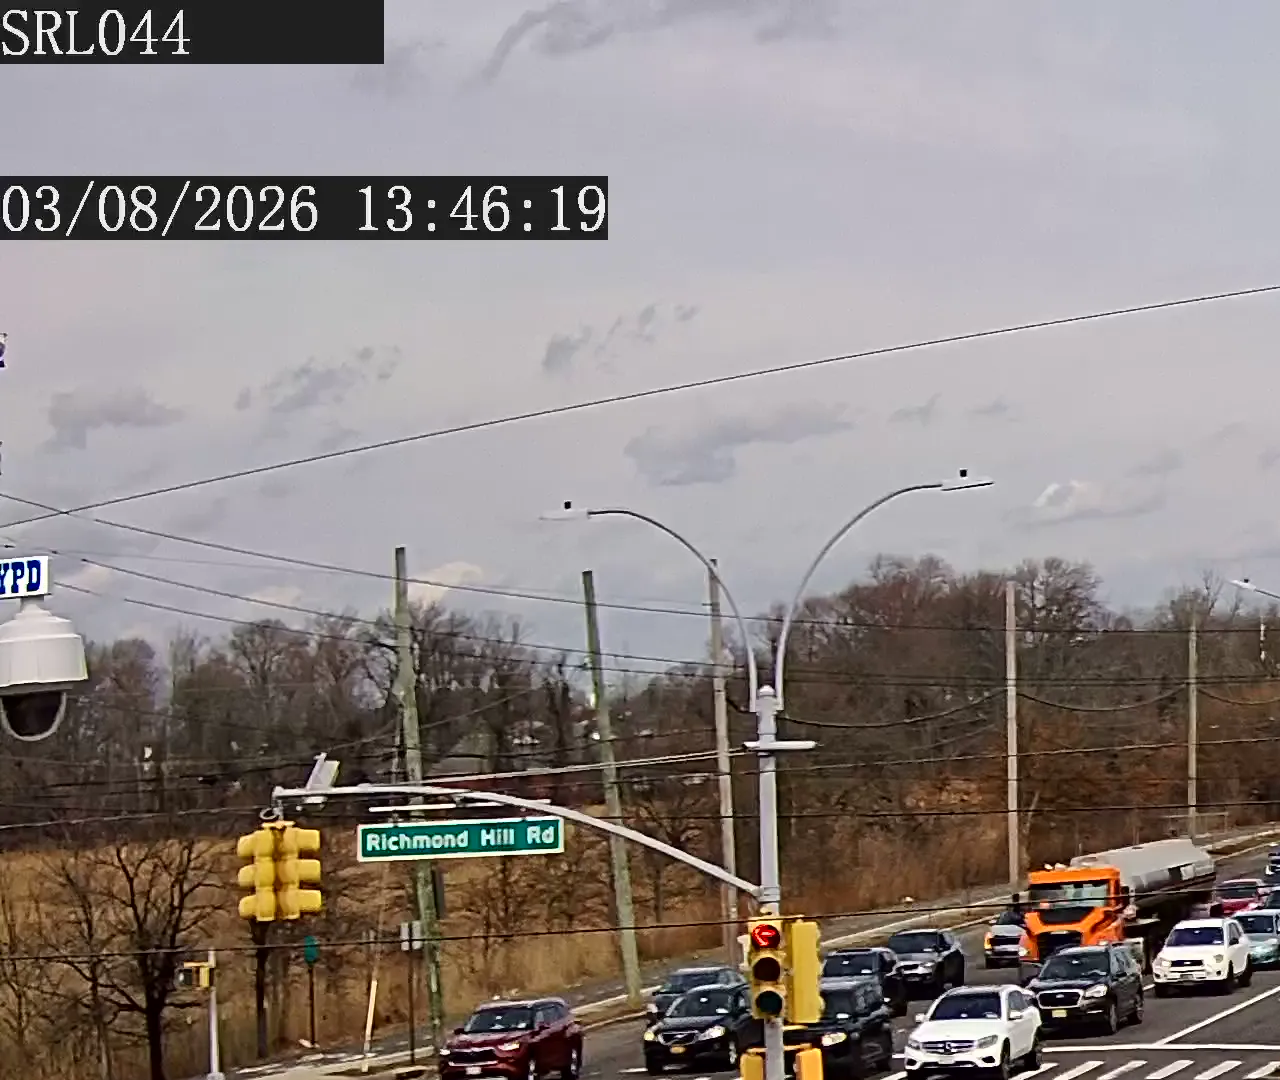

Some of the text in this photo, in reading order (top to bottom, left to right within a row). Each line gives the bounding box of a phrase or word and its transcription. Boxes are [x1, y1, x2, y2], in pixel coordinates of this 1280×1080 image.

[366, 825, 555, 852] Richmond Hill Rd
